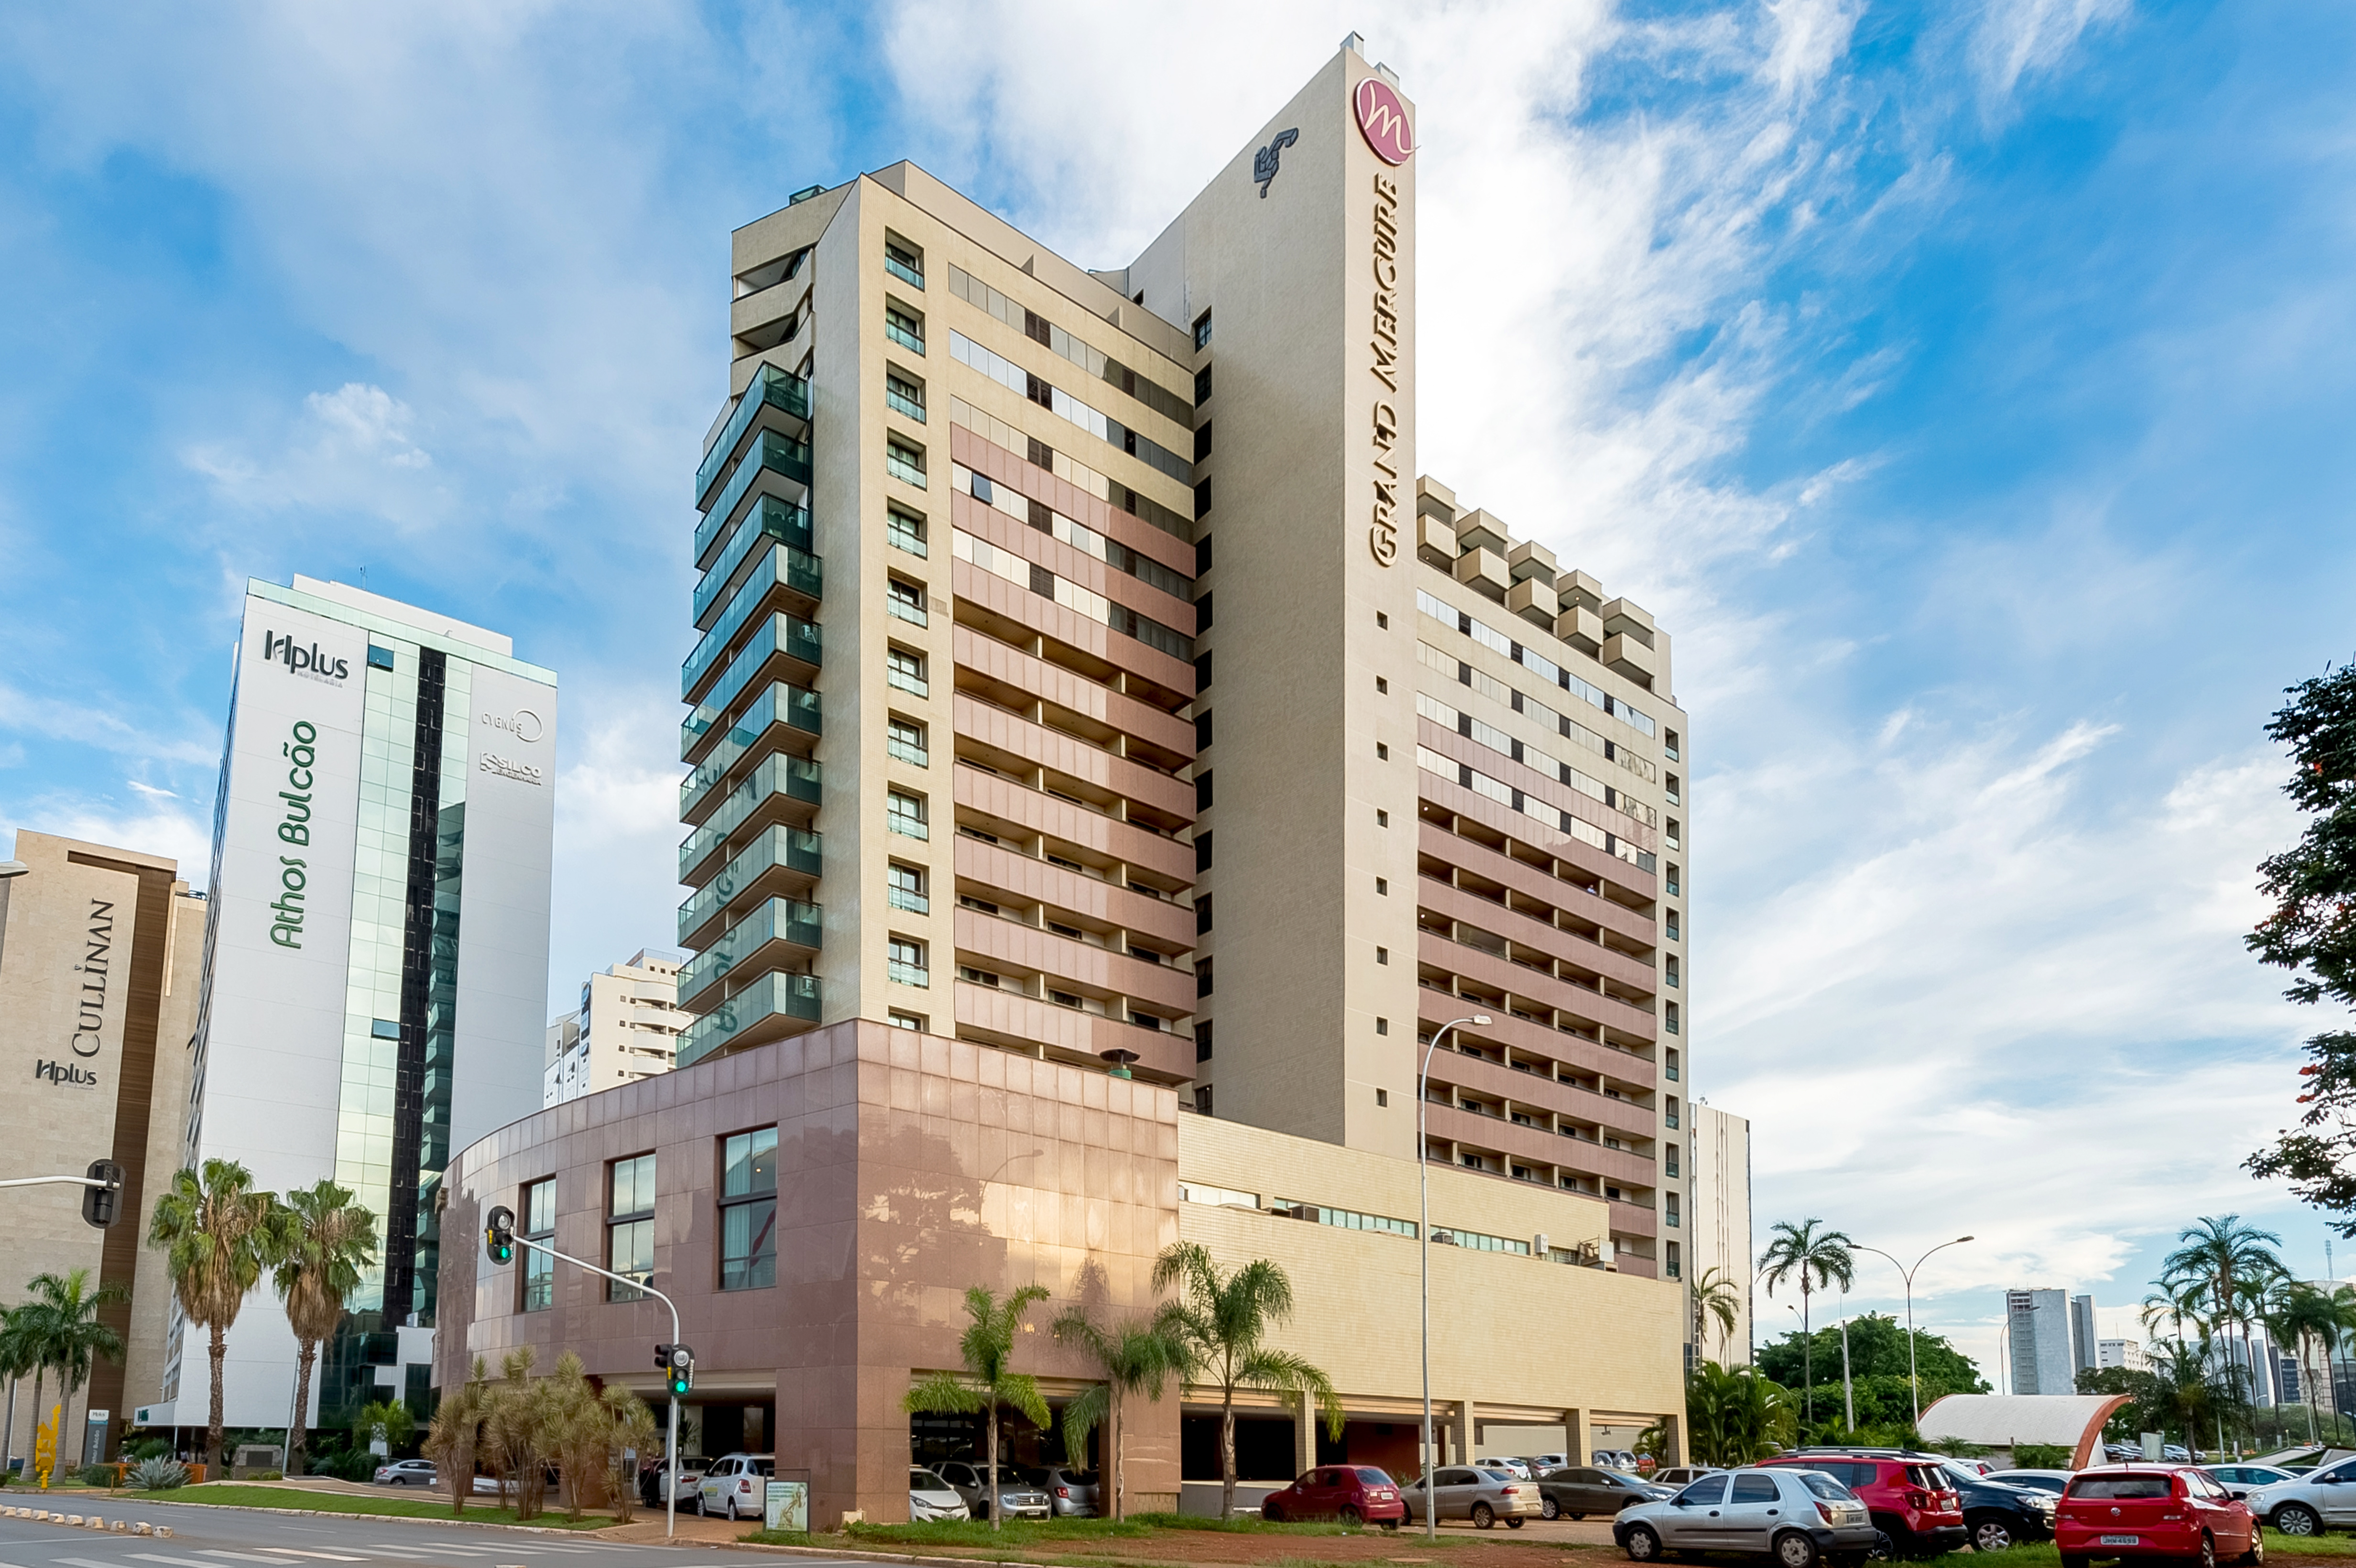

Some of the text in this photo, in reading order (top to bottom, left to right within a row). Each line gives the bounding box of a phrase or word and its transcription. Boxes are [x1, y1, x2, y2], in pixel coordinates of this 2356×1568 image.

[1370, 172, 1398, 567] GRAND MERCURE
[270, 720, 317, 949] Athos Bulcão
[497, 757, 543, 779] SILCO
